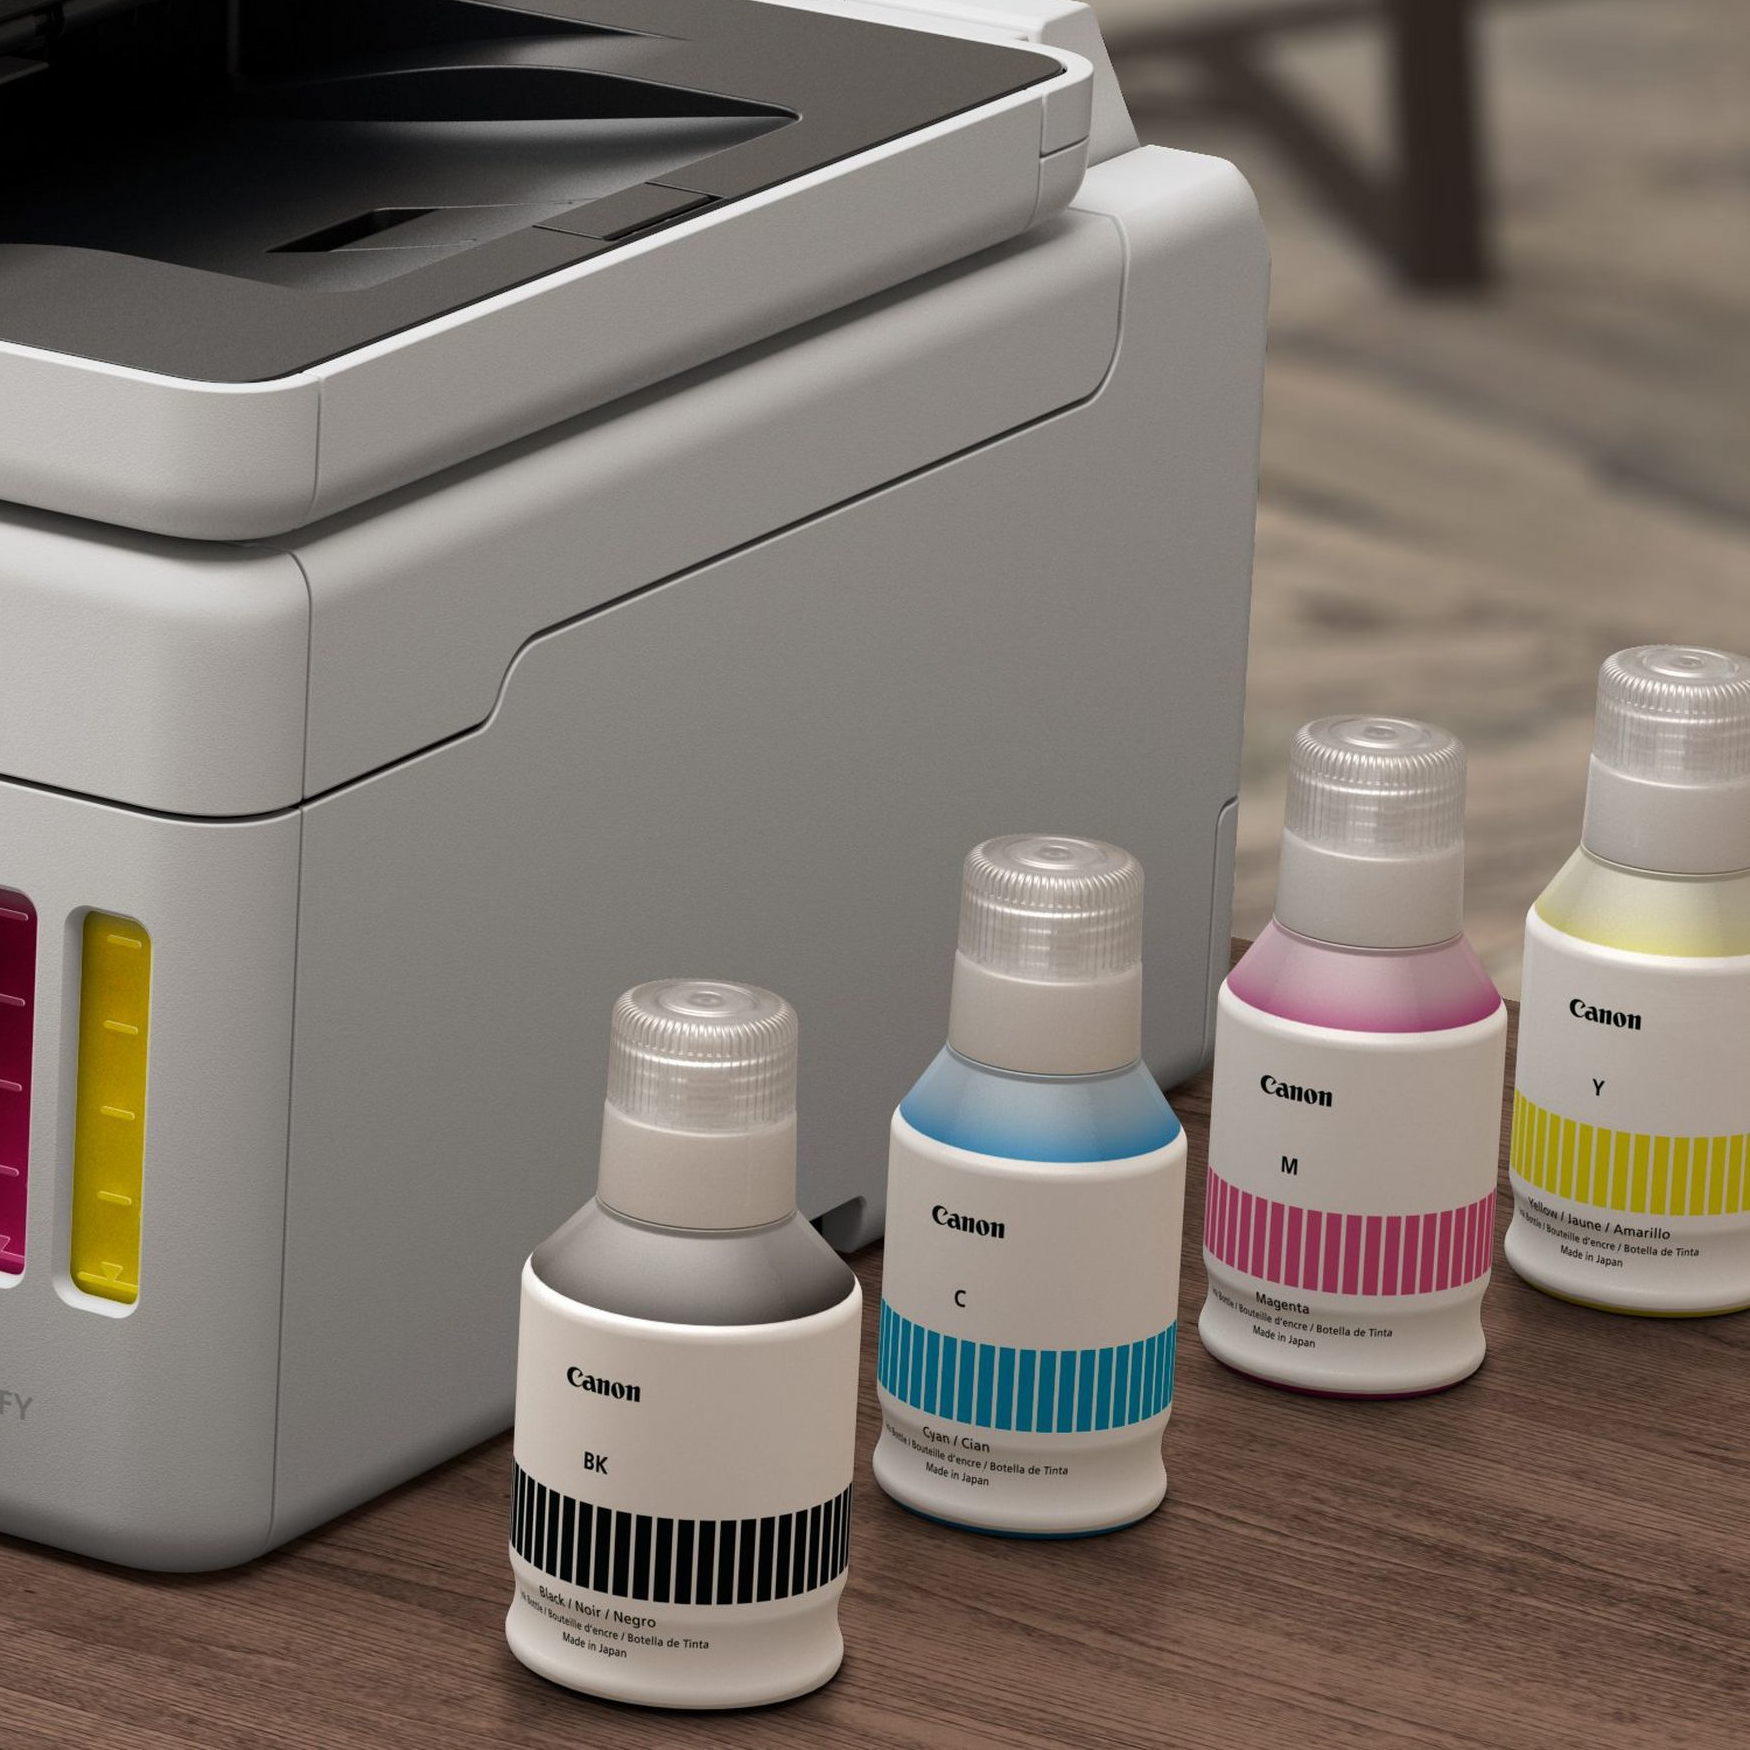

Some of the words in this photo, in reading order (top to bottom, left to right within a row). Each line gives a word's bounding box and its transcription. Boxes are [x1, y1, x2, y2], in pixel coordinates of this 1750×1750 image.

[1569, 998, 1642, 1031] Canon
[1260, 1074, 1333, 1107] Canon
[1592, 1078, 1605, 1097] Y
[1281, 1156, 1299, 1176] M
[932, 1205, 1006, 1239] Canon
[1528, 1196, 1558, 1219] Yellow
[1568, 1213, 1601, 1232] Jaune
[1614, 1224, 1671, 1240] Amarillo
[1560, 1245, 1583, 1260] Made
[1585, 1252, 1594, 1263] in
[1596, 1255, 1623, 1269] Japan
[1582, 1236, 1616, 1252] d'encre
[1624, 1244, 1658, 1257] Botella
[1661, 1248, 1673, 1257] de
[1676, 1248, 1700, 1257] Tinta
[954, 1289, 967, 1308] C
[1255, 1291, 1310, 1315] Magenta
[1252, 1324, 1276, 1340] Made
[1277, 1332, 1286, 1343] in
[1288, 1335, 1316, 1349] Japan
[1274, 1316, 1308, 1332] d'encre
[1316, 1324, 1351, 1337] Botella
[1353, 1328, 1366, 1337] de
[1369, 1328, 1393, 1338] Tinta
[566, 1366, 641, 1402] Canon
[922, 1426, 950, 1443] Cyan
[961, 1437, 991, 1453] Cian
[583, 1451, 609, 1475] BK
[925, 1461, 949, 1478] Made
[950, 1470, 960, 1480] in
[961, 1473, 989, 1487] Japan
[948, 1453, 982, 1469] d'encre
[990, 1462, 1025, 1475] Botella
[1028, 1466, 1041, 1475] de
[1044, 1466, 1069, 1476] Tinta
[539, 1585, 566, 1607] Black
[575, 1600, 601, 1617] Noir
[614, 1611, 656, 1629] Negro
[562, 1631, 586, 1648] Made
[588, 1640, 597, 1651] in
[598, 1644, 627, 1658] Japan
[584, 1624, 619, 1640] d'encre
[628, 1633, 664, 1648] Botella
[667, 1638, 680, 1648] de
[683, 1639, 709, 1650] Tinta
